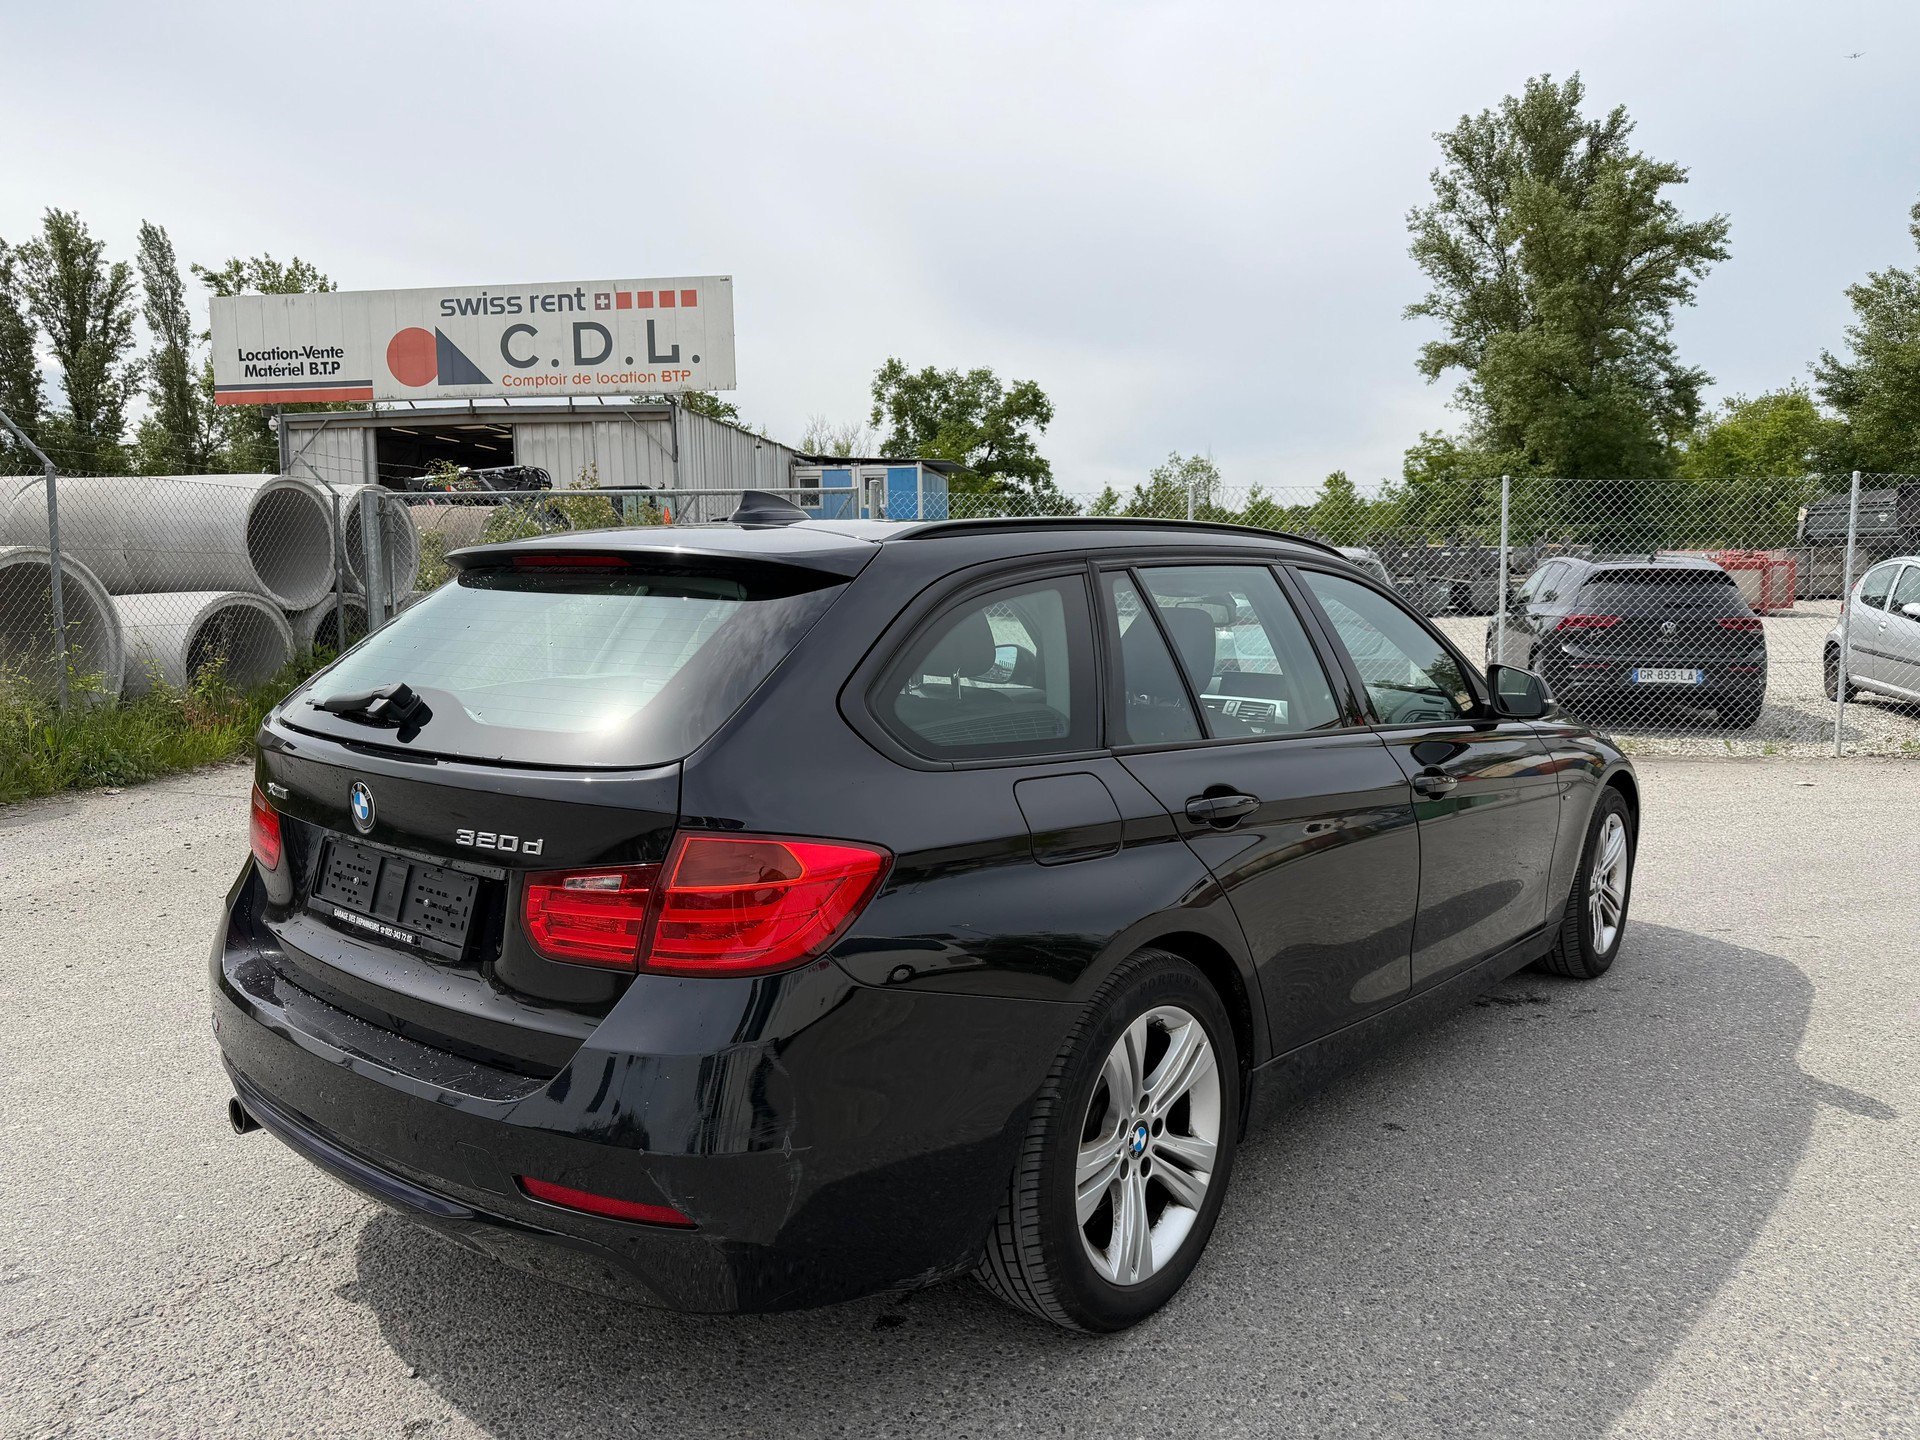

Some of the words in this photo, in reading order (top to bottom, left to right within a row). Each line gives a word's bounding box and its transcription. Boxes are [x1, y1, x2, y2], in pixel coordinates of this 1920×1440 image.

[440, 291, 523, 317] swiss
[529, 287, 586, 313] rent
[238, 345, 345, 362] Location-Vente
[244, 361, 305, 378] Matériel
[309, 361, 341, 376] B.T.P
[502, 373, 567, 389] Comptoir
[572, 373, 592, 385] de
[596, 370, 656, 384] location
[661, 369, 692, 383] BTP
[455, 828, 544, 856] 320d
[334, 909, 349, 920] GARAGE
